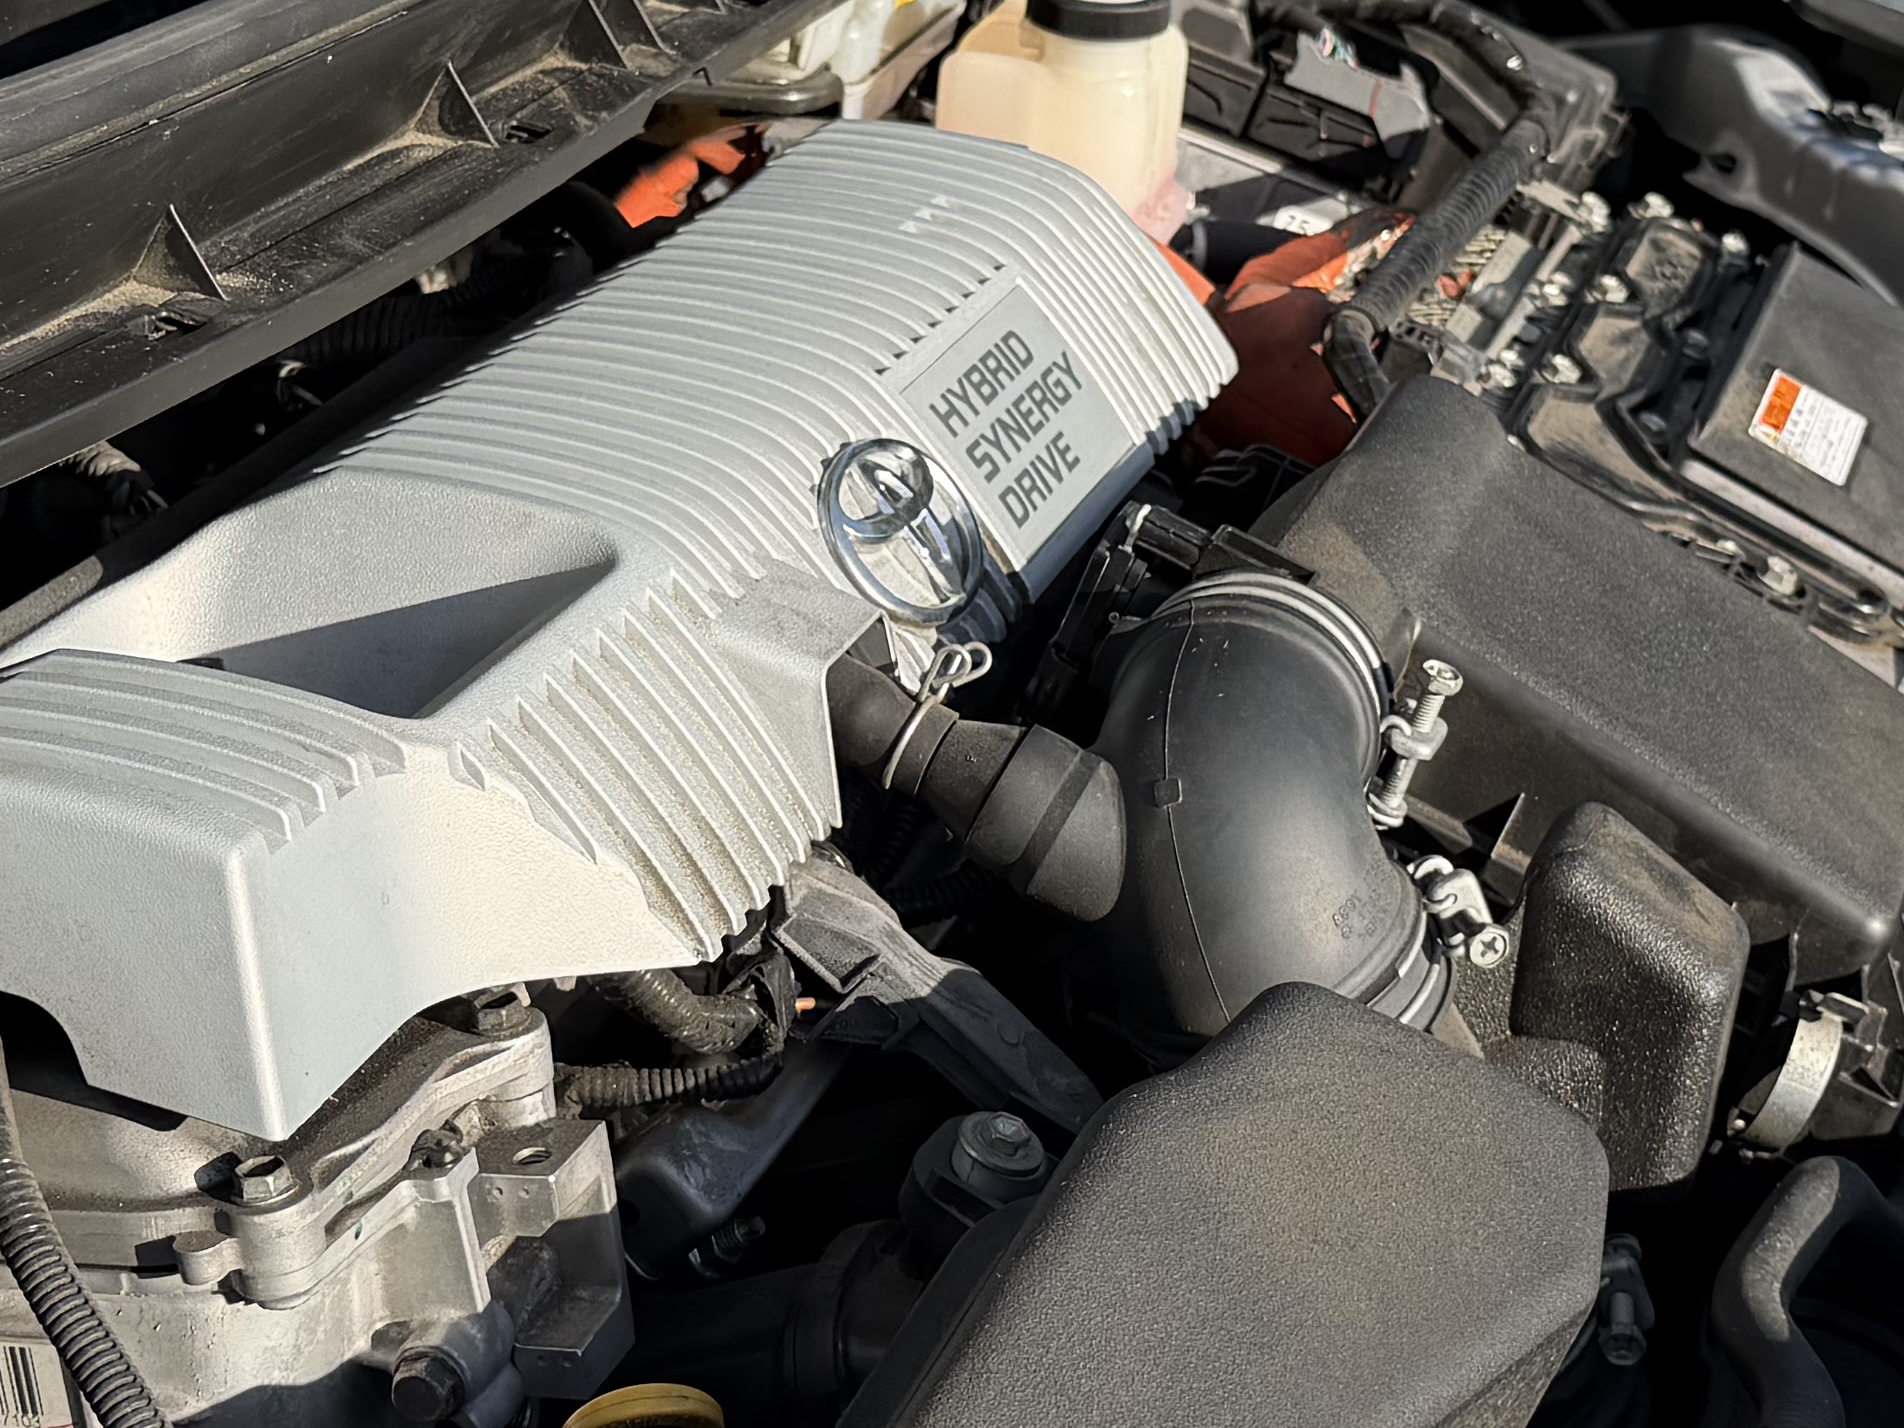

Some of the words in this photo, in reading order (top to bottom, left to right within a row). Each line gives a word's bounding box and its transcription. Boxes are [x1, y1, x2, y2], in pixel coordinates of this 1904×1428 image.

[928, 329, 1035, 439] HYBRID
[964, 350, 1083, 485] SYNERGY
[997, 430, 1082, 530] DRIVE
